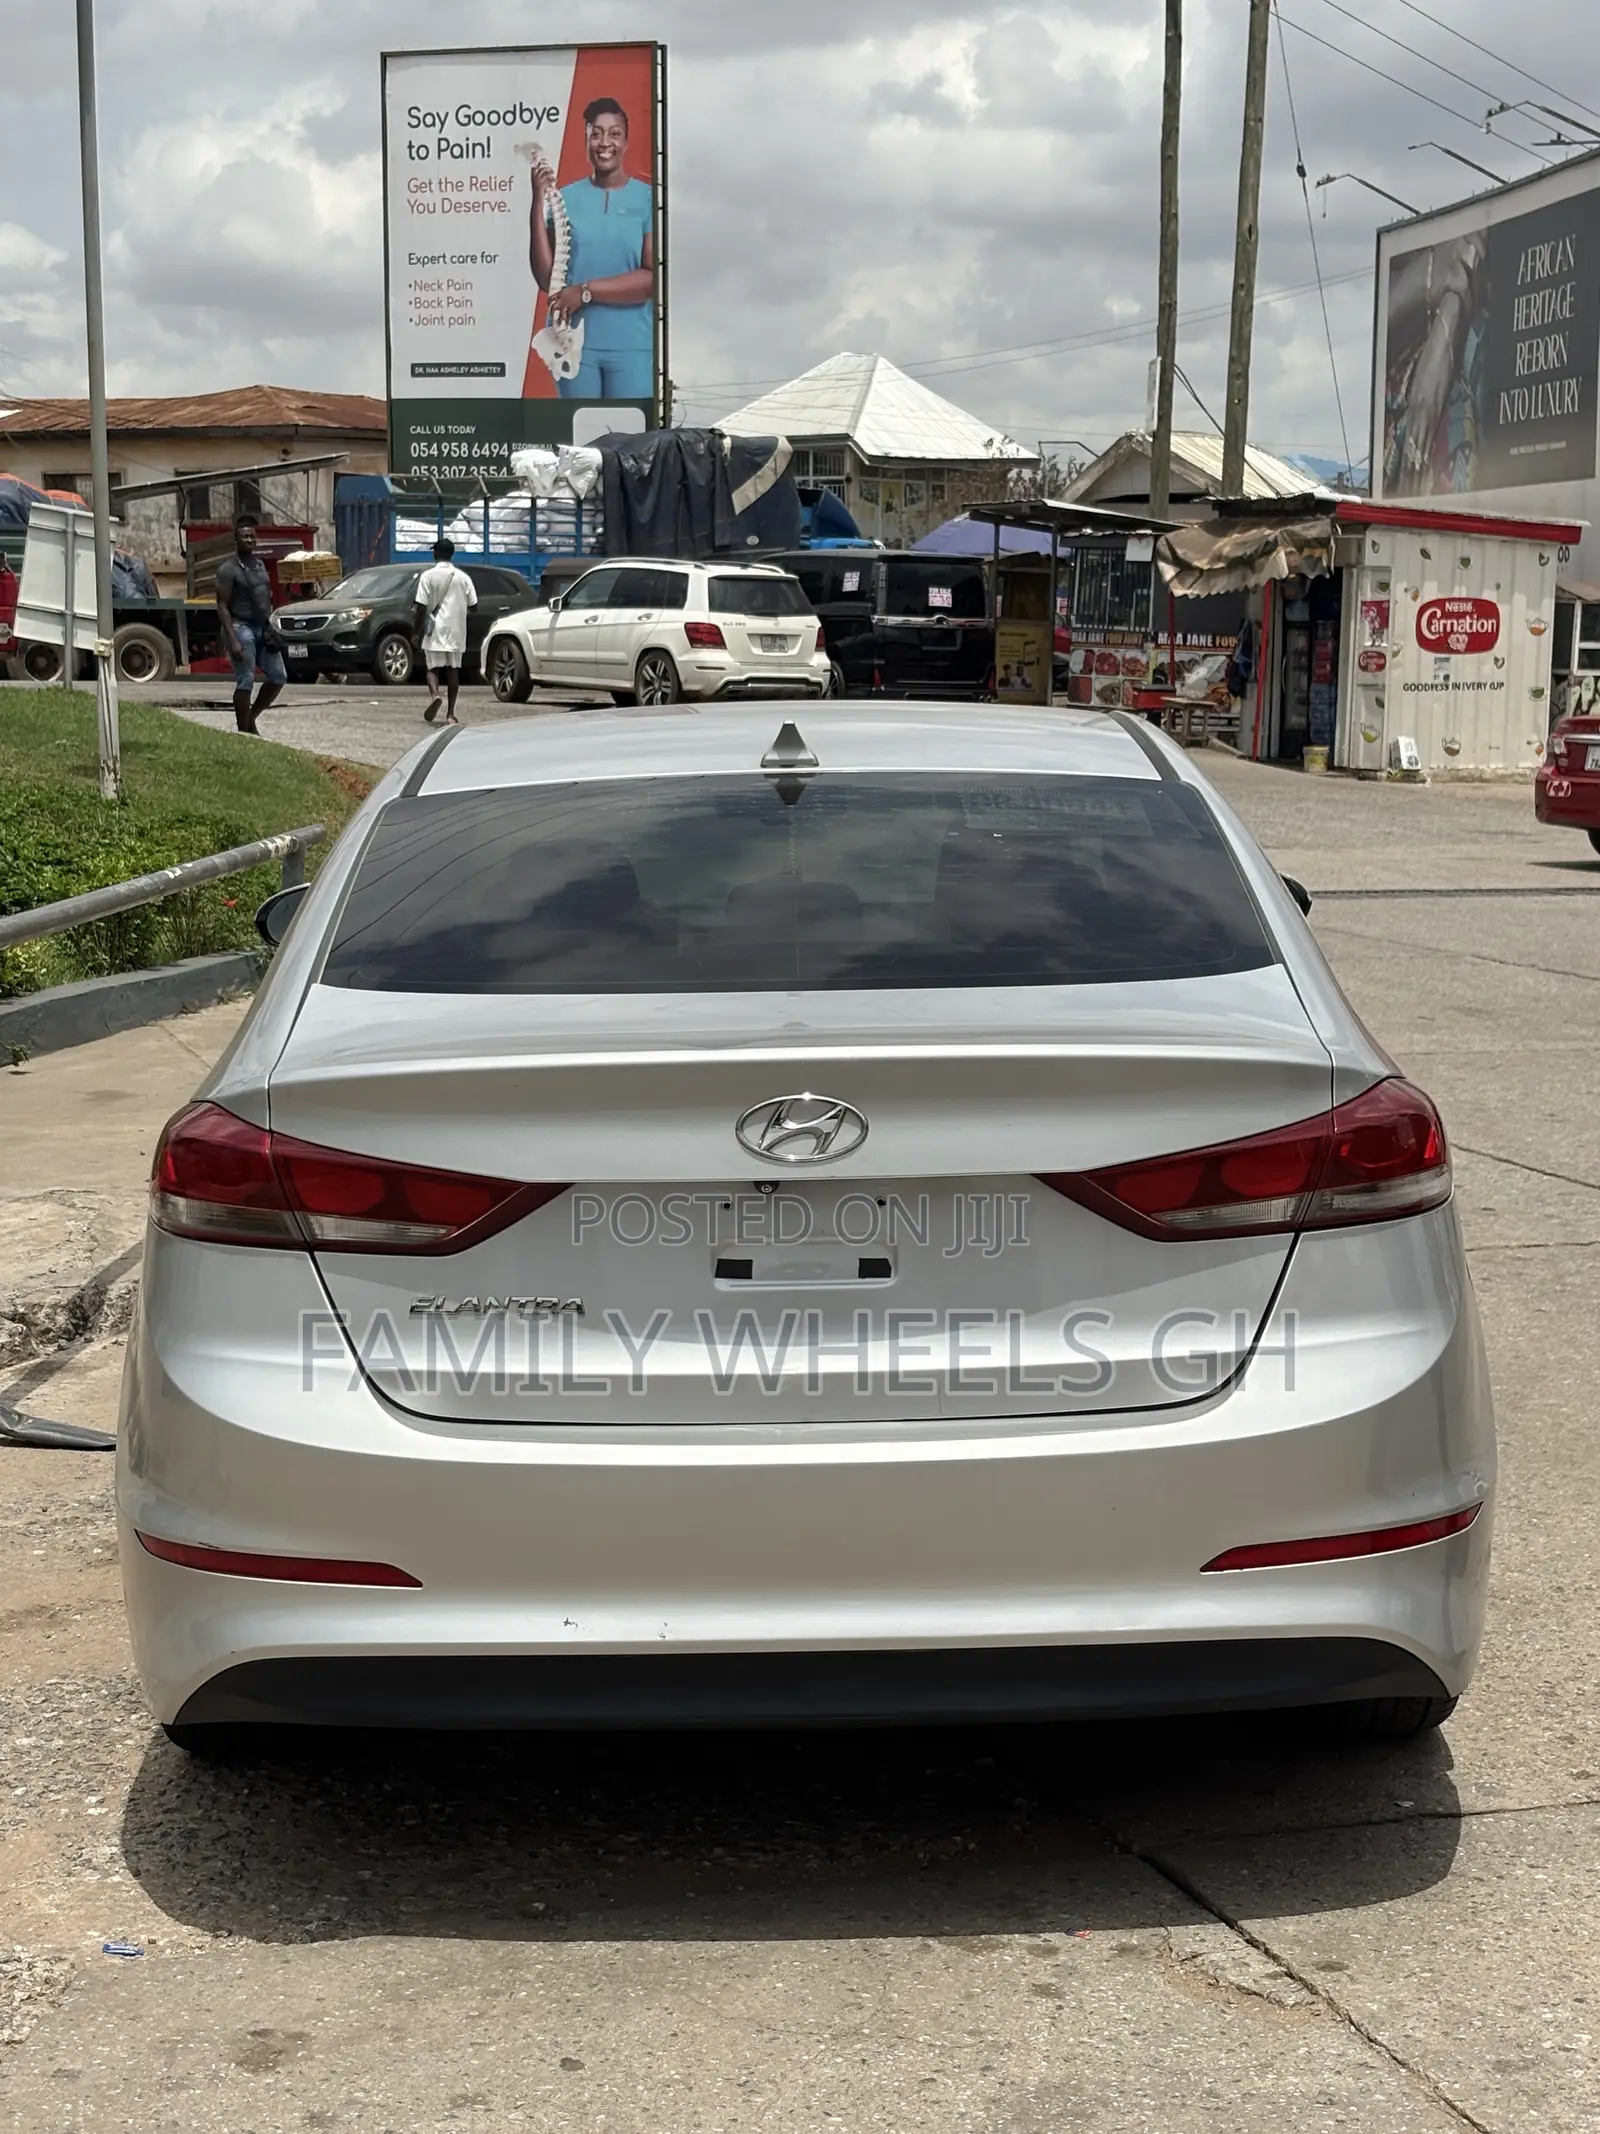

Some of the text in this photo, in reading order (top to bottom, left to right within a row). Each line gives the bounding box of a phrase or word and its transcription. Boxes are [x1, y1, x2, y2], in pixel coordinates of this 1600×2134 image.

[407, 102, 560, 134] Say Goodbye
[407, 136, 491, 161] to Pain!
[407, 175, 514, 193] Get the Relief
[406, 198, 511, 214] You Deserve.
[408, 251, 499, 268] Expert care for
[1517, 233, 1576, 285] AFRICAN
[413, 279, 473, 292] Neck Pain
[414, 296, 473, 309] Back Pain
[1513, 281, 1576, 332] HERITAGE
[414, 313, 476, 328] Joint pain
[1516, 331, 1569, 377] REBORN
[1499, 375, 1582, 425] INTO LUXURY
[410, 425, 476, 435] CALL US TODAY
[410, 442, 509, 458] 054 958 6494
[1420, 607, 1497, 640] Carnation
[1186, 633, 1213, 647] JANE
[1462, 682, 1487, 691] EVERY
[408, 1295, 586, 1317] ELANTRA
